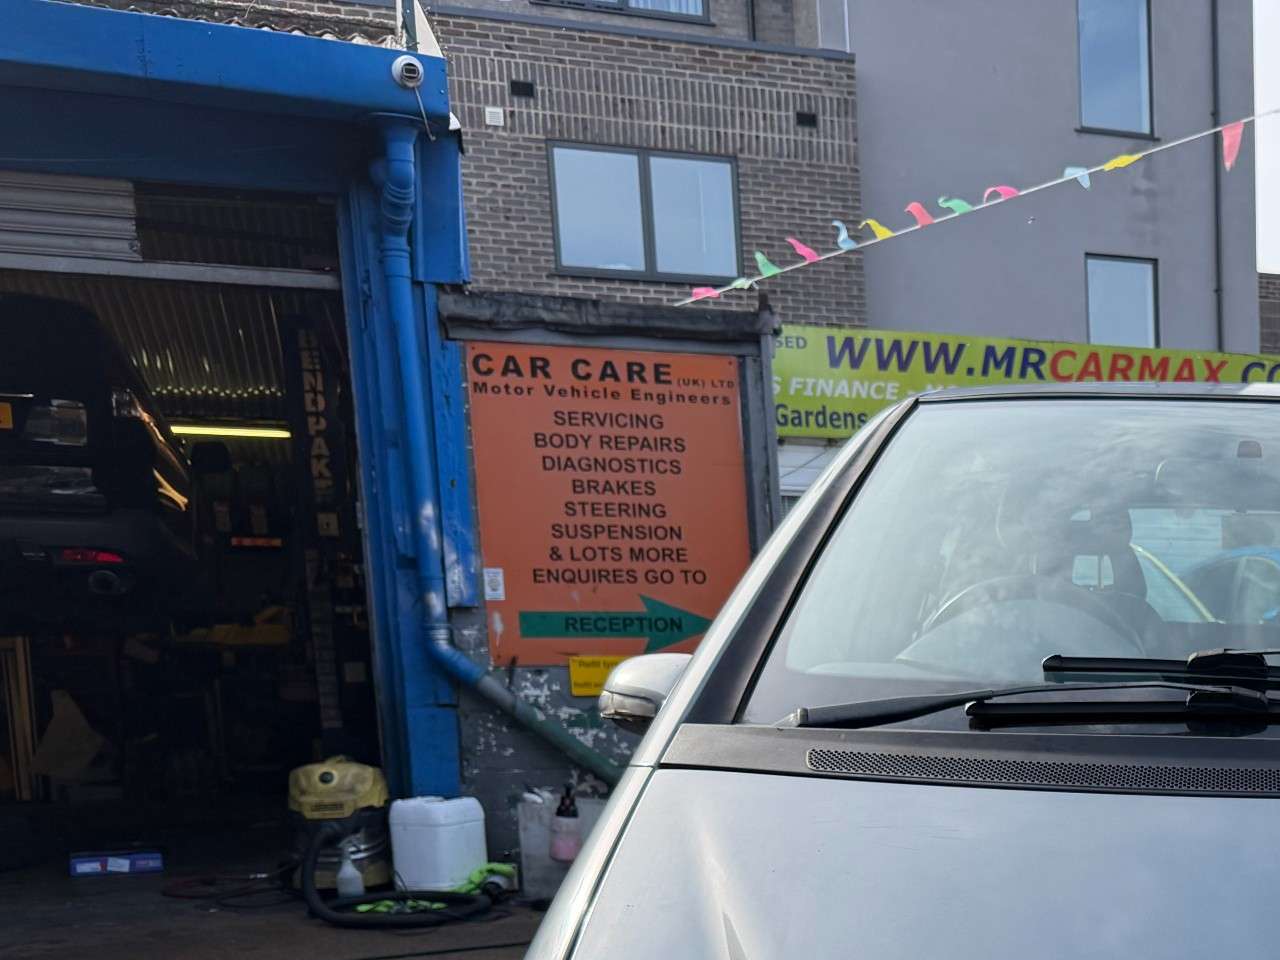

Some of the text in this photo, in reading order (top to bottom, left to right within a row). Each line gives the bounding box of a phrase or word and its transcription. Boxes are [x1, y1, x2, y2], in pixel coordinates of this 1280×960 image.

[472, 353, 551, 379] CAR
[571, 358, 672, 384] CARE
[711, 379, 734, 388] LTD
[473, 382, 731, 405] Motor Vehicle Engineers
[788, 377, 899, 399] FINANCE
[554, 410, 664, 430] SERVICING
[776, 404, 868, 429] Gardens
[534, 433, 686, 452] BODY REPAIRS
[542, 456, 681, 474] DIAGNOSTICS
[572, 479, 656, 496] BRAKES
[564, 502, 666, 518] STEERING
[551, 524, 681, 541] SUSPENSION
[549, 547, 688, 563] & LOTS MORE
[533, 568, 706, 585] ENQUIRES GO TO
[565, 616, 683, 633] RECEPTION
